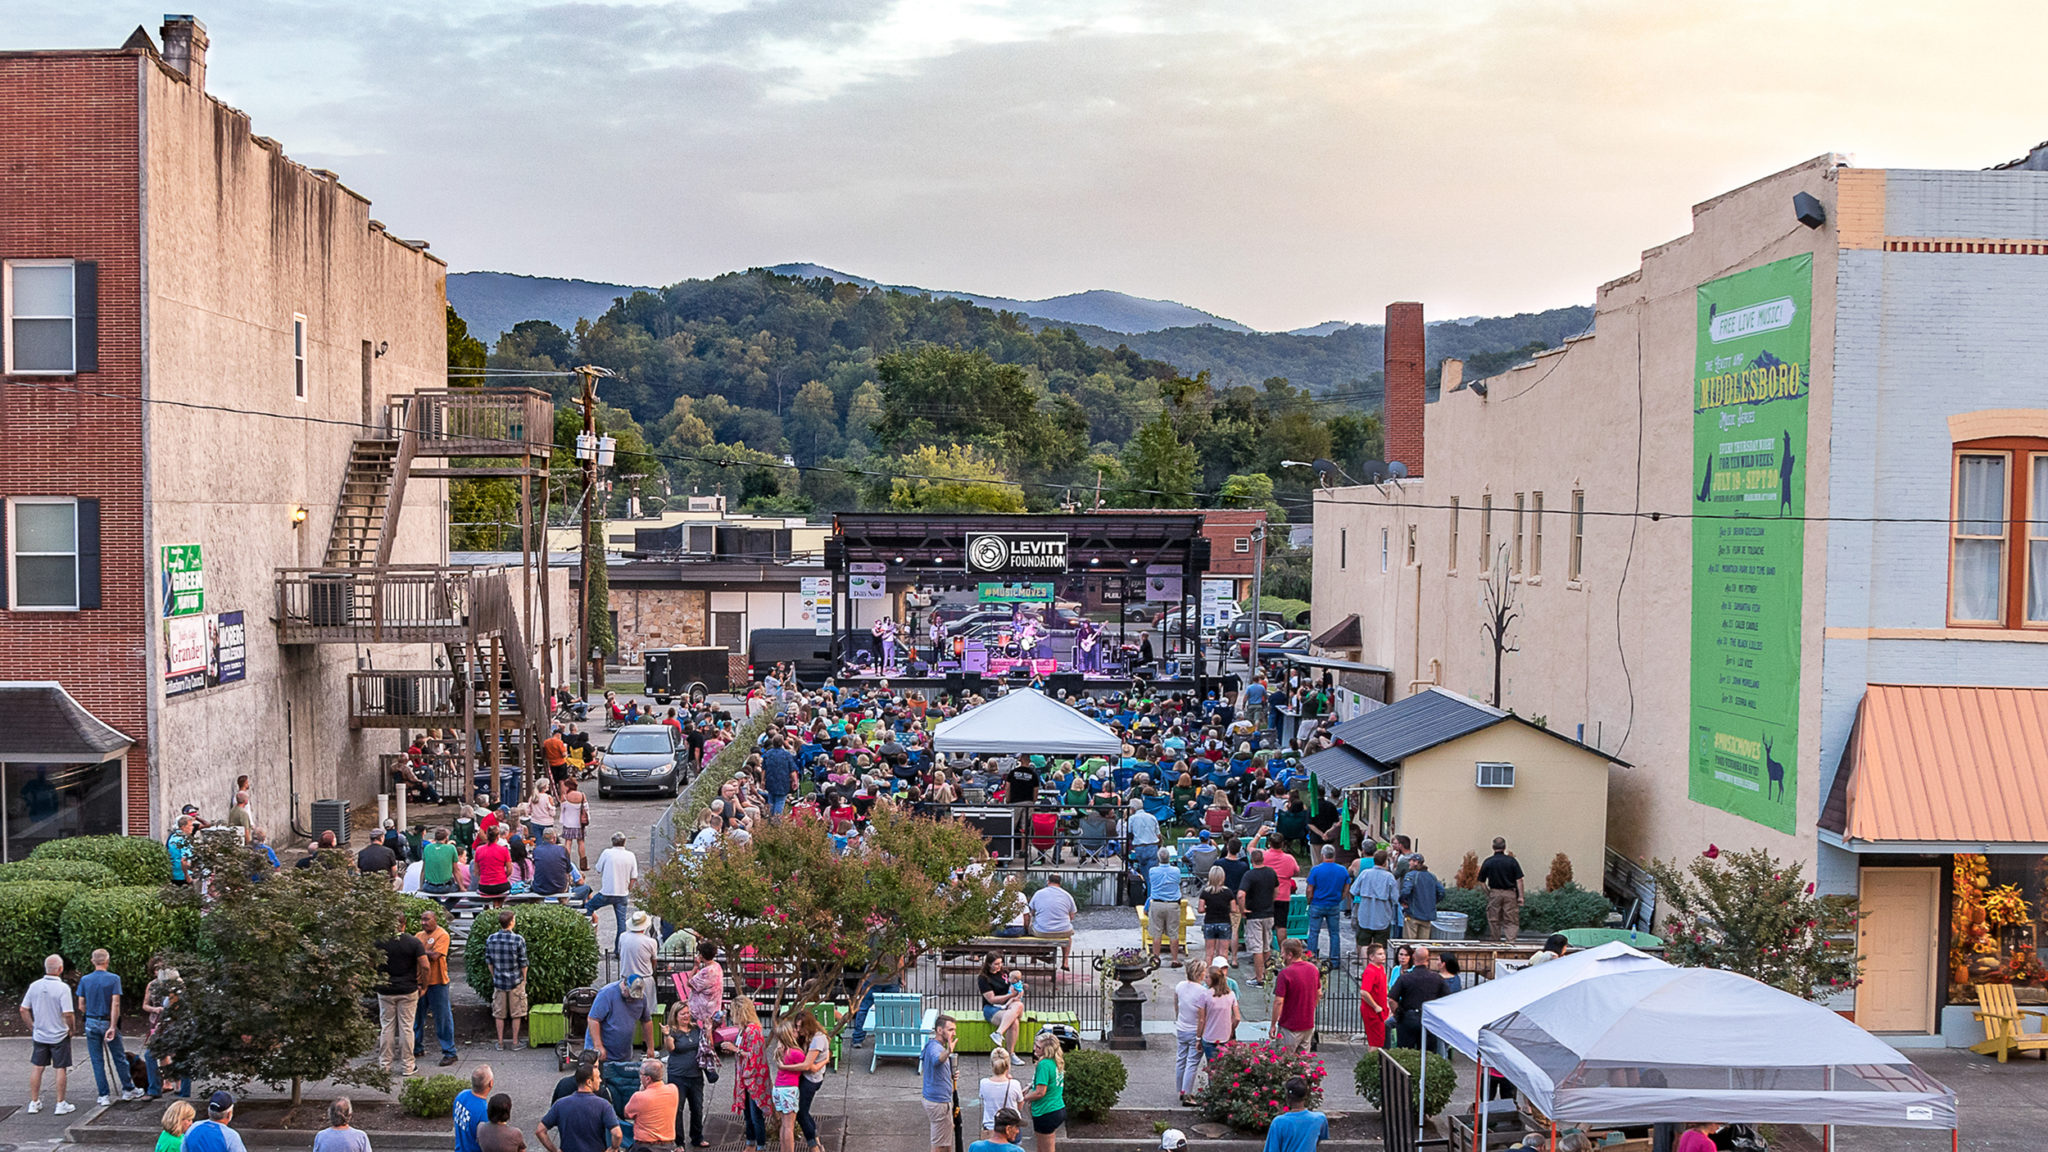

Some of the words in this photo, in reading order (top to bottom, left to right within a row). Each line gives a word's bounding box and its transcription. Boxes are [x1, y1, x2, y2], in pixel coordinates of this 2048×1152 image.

[1719, 316, 1736, 336] FREE
[1739, 311, 1755, 332] LIVE
[1758, 305, 1784, 327] MUSIC!
[1700, 362, 1800, 409] MIDDLESBORO
[1011, 541, 1066, 554] LEVITT
[1011, 555, 1066, 567] FOUNDATION
[172, 570, 203, 591] GREEN
[984, 587, 1047, 597] #MUSICMOVES
